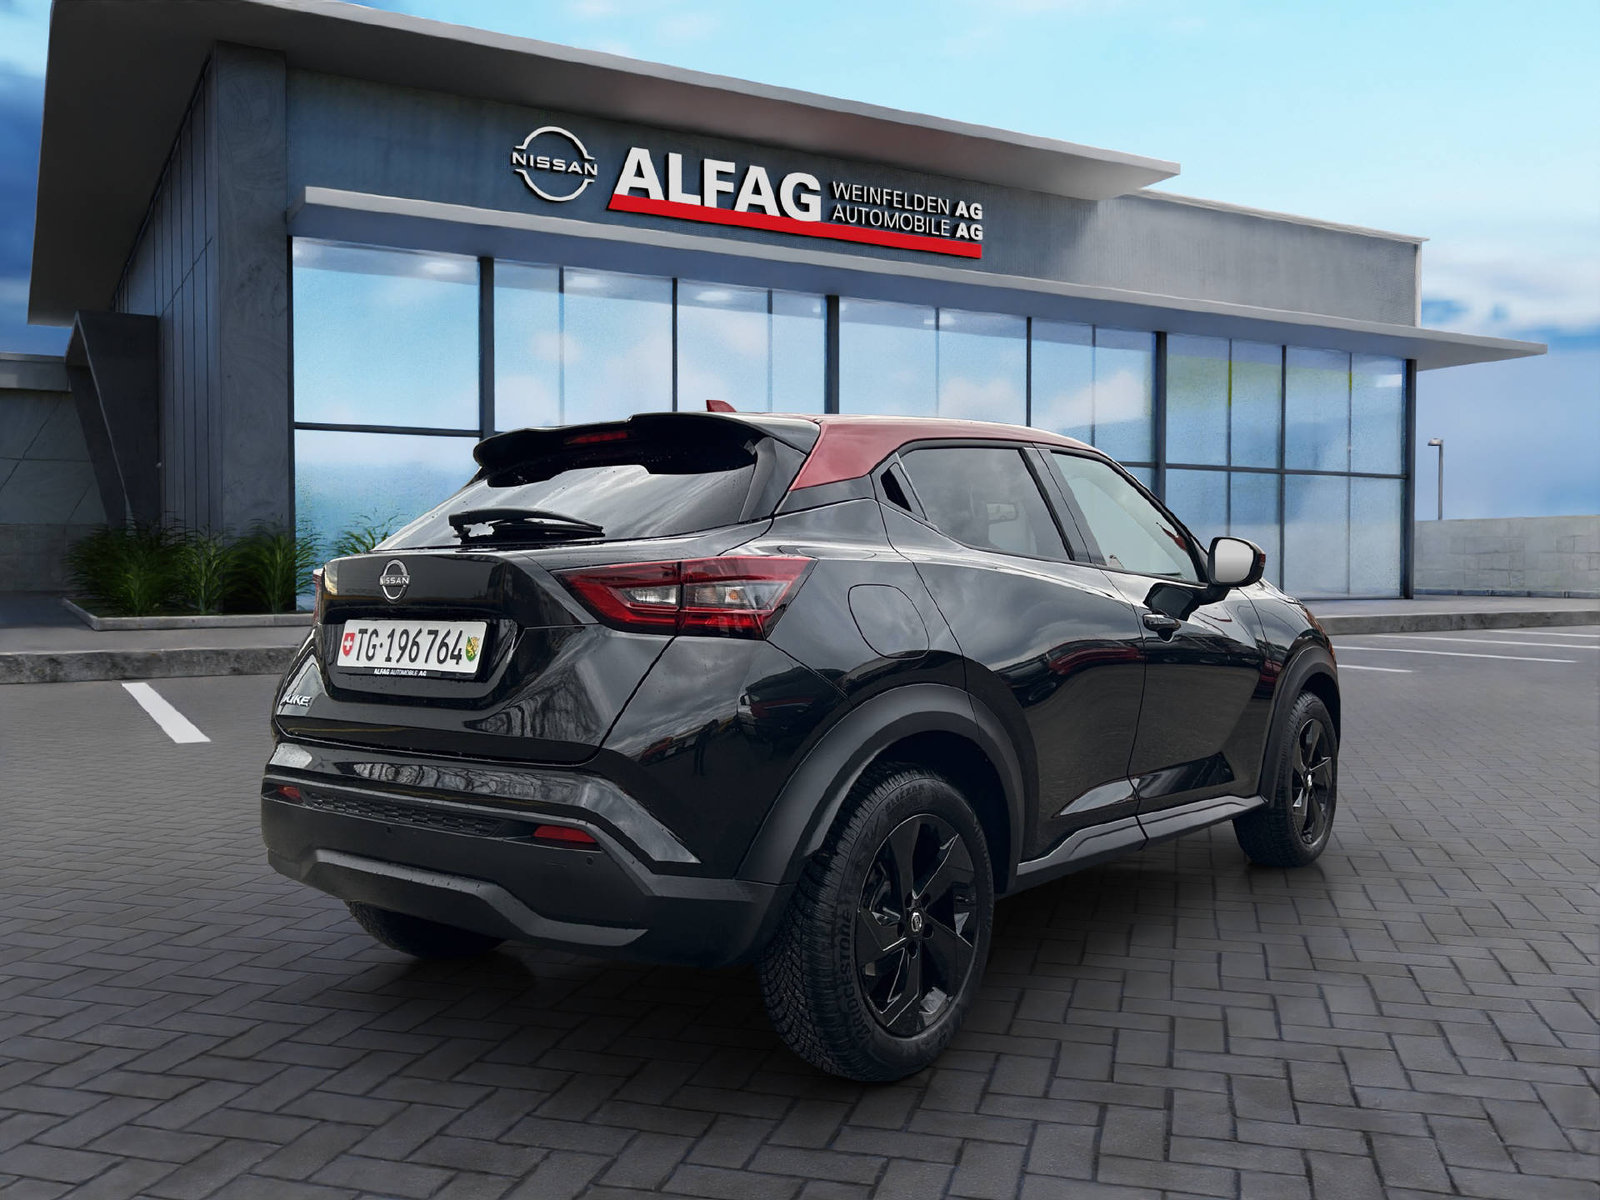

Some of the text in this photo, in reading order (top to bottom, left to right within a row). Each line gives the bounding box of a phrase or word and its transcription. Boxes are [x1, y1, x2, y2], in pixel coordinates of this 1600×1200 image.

[512, 151, 598, 176] NISSAN
[613, 146, 822, 222] ALFAG
[832, 181, 983, 220] WEINFELDEN AG
[832, 203, 984, 241] AUTOMOBILE AG
